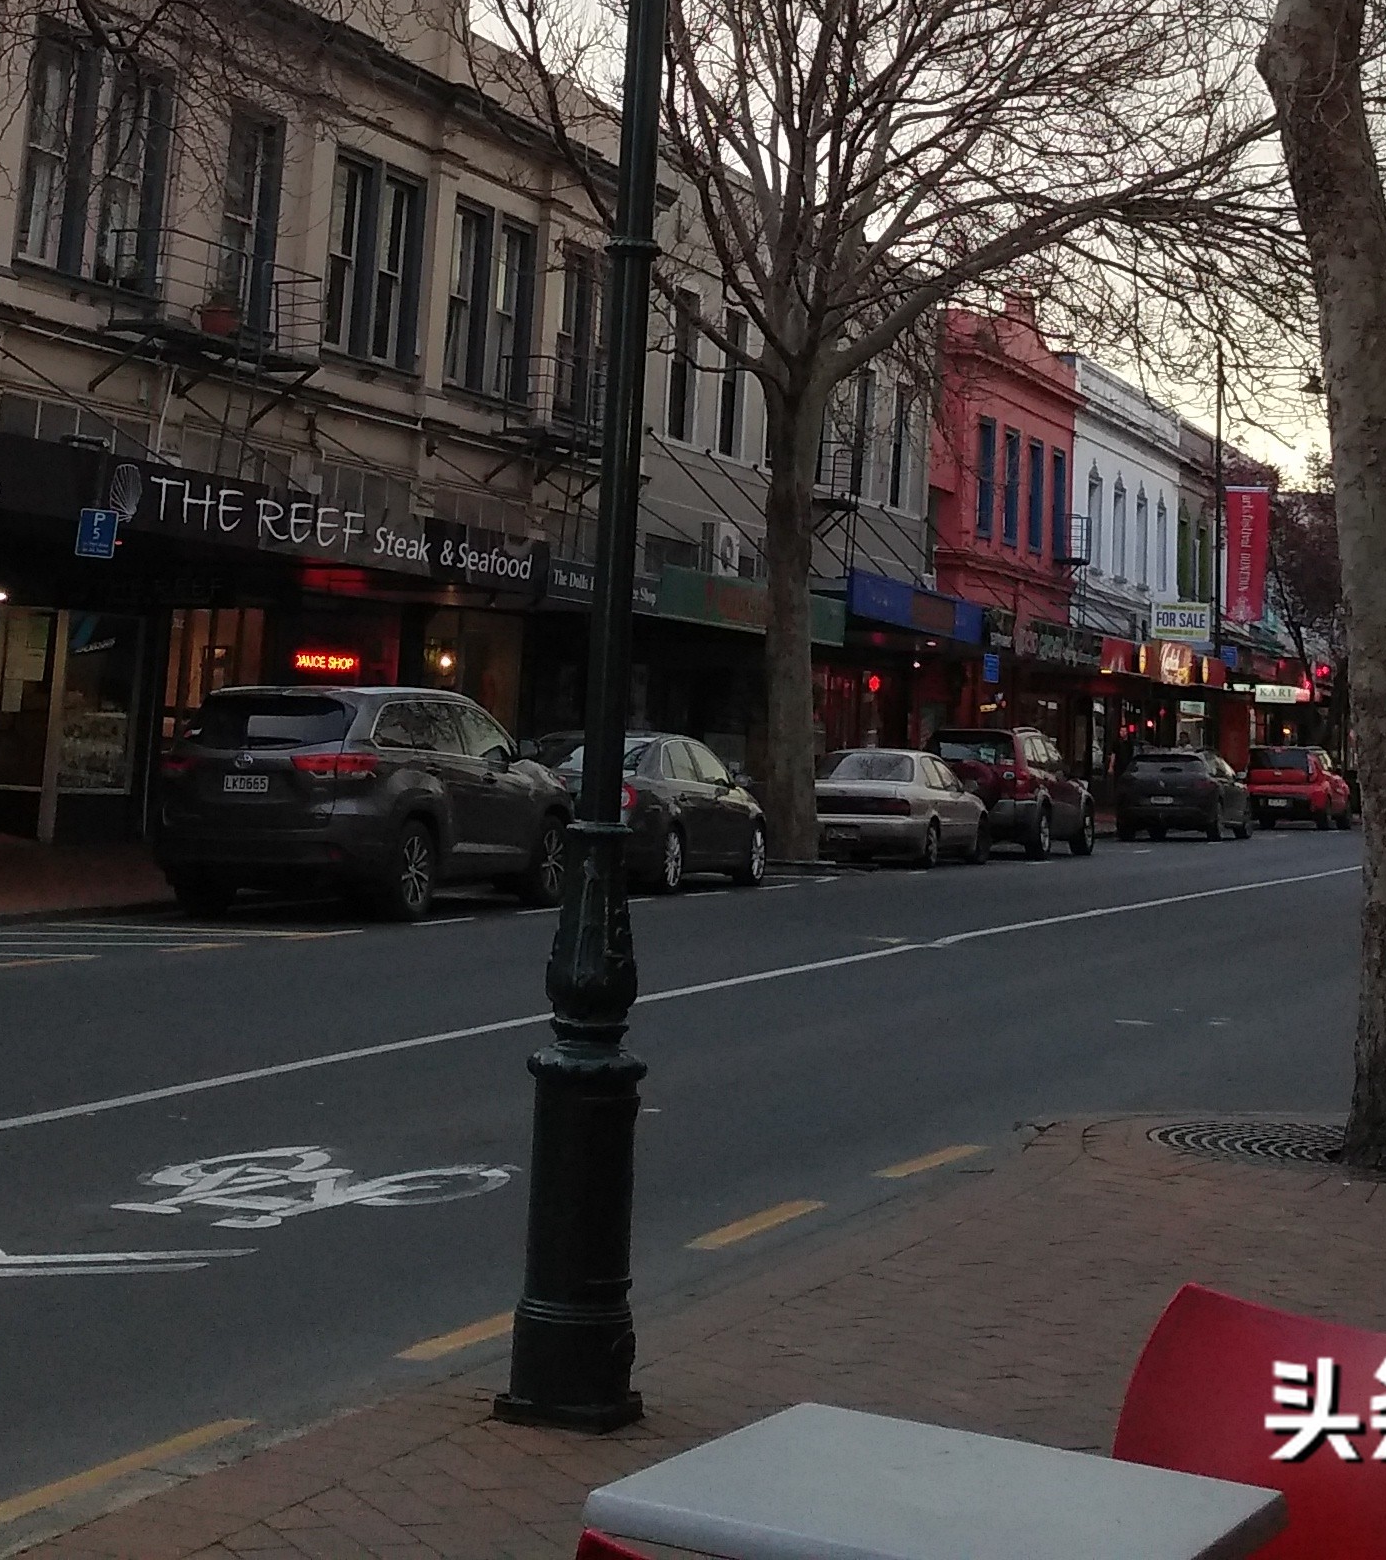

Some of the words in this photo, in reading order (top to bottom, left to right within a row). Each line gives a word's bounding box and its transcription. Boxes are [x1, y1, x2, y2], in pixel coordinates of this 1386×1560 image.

[93, 512, 106, 527] P
[92, 527, 101, 540] 5
[150, 474, 245, 533] THE
[255, 497, 367, 553] REEF
[372, 526, 433, 563] Steak
[456, 542, 533, 581] Seafood
[1156, 611, 1177, 628] FOR
[1178, 612, 1206, 629] SALE
[327, 655, 355, 671] SHOP
[225, 776, 267, 790] LKD665
